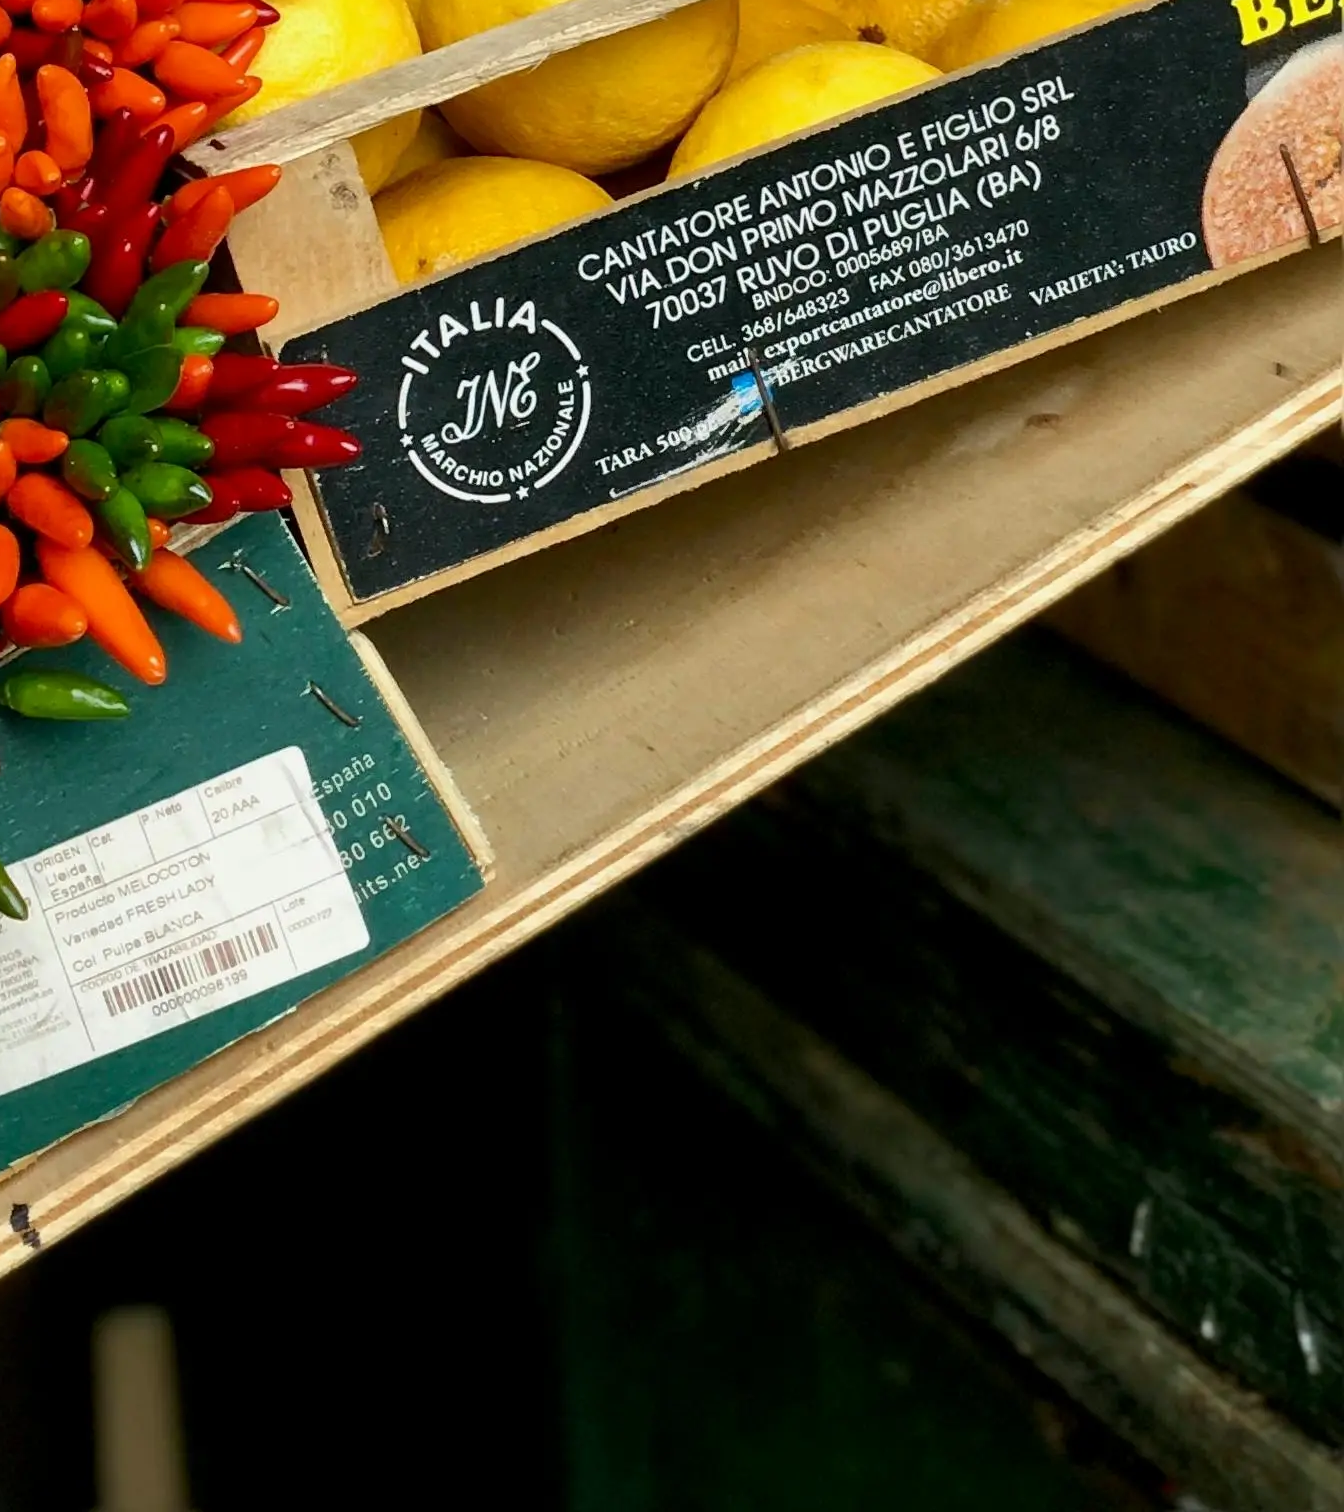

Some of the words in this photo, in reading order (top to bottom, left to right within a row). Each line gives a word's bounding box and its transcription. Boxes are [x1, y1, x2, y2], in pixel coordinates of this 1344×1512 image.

[578, 194, 752, 281] CANTATORE
[759, 143, 891, 215] ANTONIO
[897, 131, 918, 161] E
[921, 96, 1016, 152] FIGLIO
[1021, 76, 1075, 114] SRL
[605, 268, 662, 306] VIA
[666, 236, 738, 285] DON
[741, 199, 837, 255] PRIMO
[842, 132, 1010, 217] MAZZOLARI
[1015, 114, 1061, 152] 6/8
[645, 275, 727, 330] 70037
[736, 243, 820, 294] RUVO
[825, 227, 859, 260] DI
[863, 187, 971, 246] PUGLIA
[977, 160, 1042, 208] (BA)
[752, 269, 832, 311] BNDOO:
[835, 224, 950, 280] 0005689/BA
[1125, 231, 1197, 270] TAURO
[687, 334, 737, 363] CELL.
[741, 288, 850, 343] 368/648323
[869, 268, 906, 294] FAX
[909, 219, 1030, 280] 080/3613470
[707, 346, 760, 382] mail
[764, 249, 1024, 360] exportcantatore@libero.it
[401, 297, 536, 375] ITALIA
[776, 283, 1012, 387] BERGWARECANTATORE
[421, 433, 503, 487] MARCHIO
[508, 379, 575, 483] NAZIONALE
[595, 443, 654, 475] TARA
[656, 426, 692, 453] 500
[204, 775, 243, 799] Calibre
[211, 806, 229, 824] 20
[231, 794, 261, 817] AAA
[351, 782, 392, 818] 010
[33, 846, 82, 874] ORIGEN
[45, 862, 88, 888] Lleida
[50, 874, 103, 902] España
[54, 891, 116, 925] Producto
[117, 851, 212, 898] MELOCOTON
[62, 912, 124, 947] Variedad
[125, 891, 177, 921] FRESH
[179, 875, 216, 902] LADY
[144, 910, 205, 945] BLANCA
[281, 895, 306, 914] Lote
